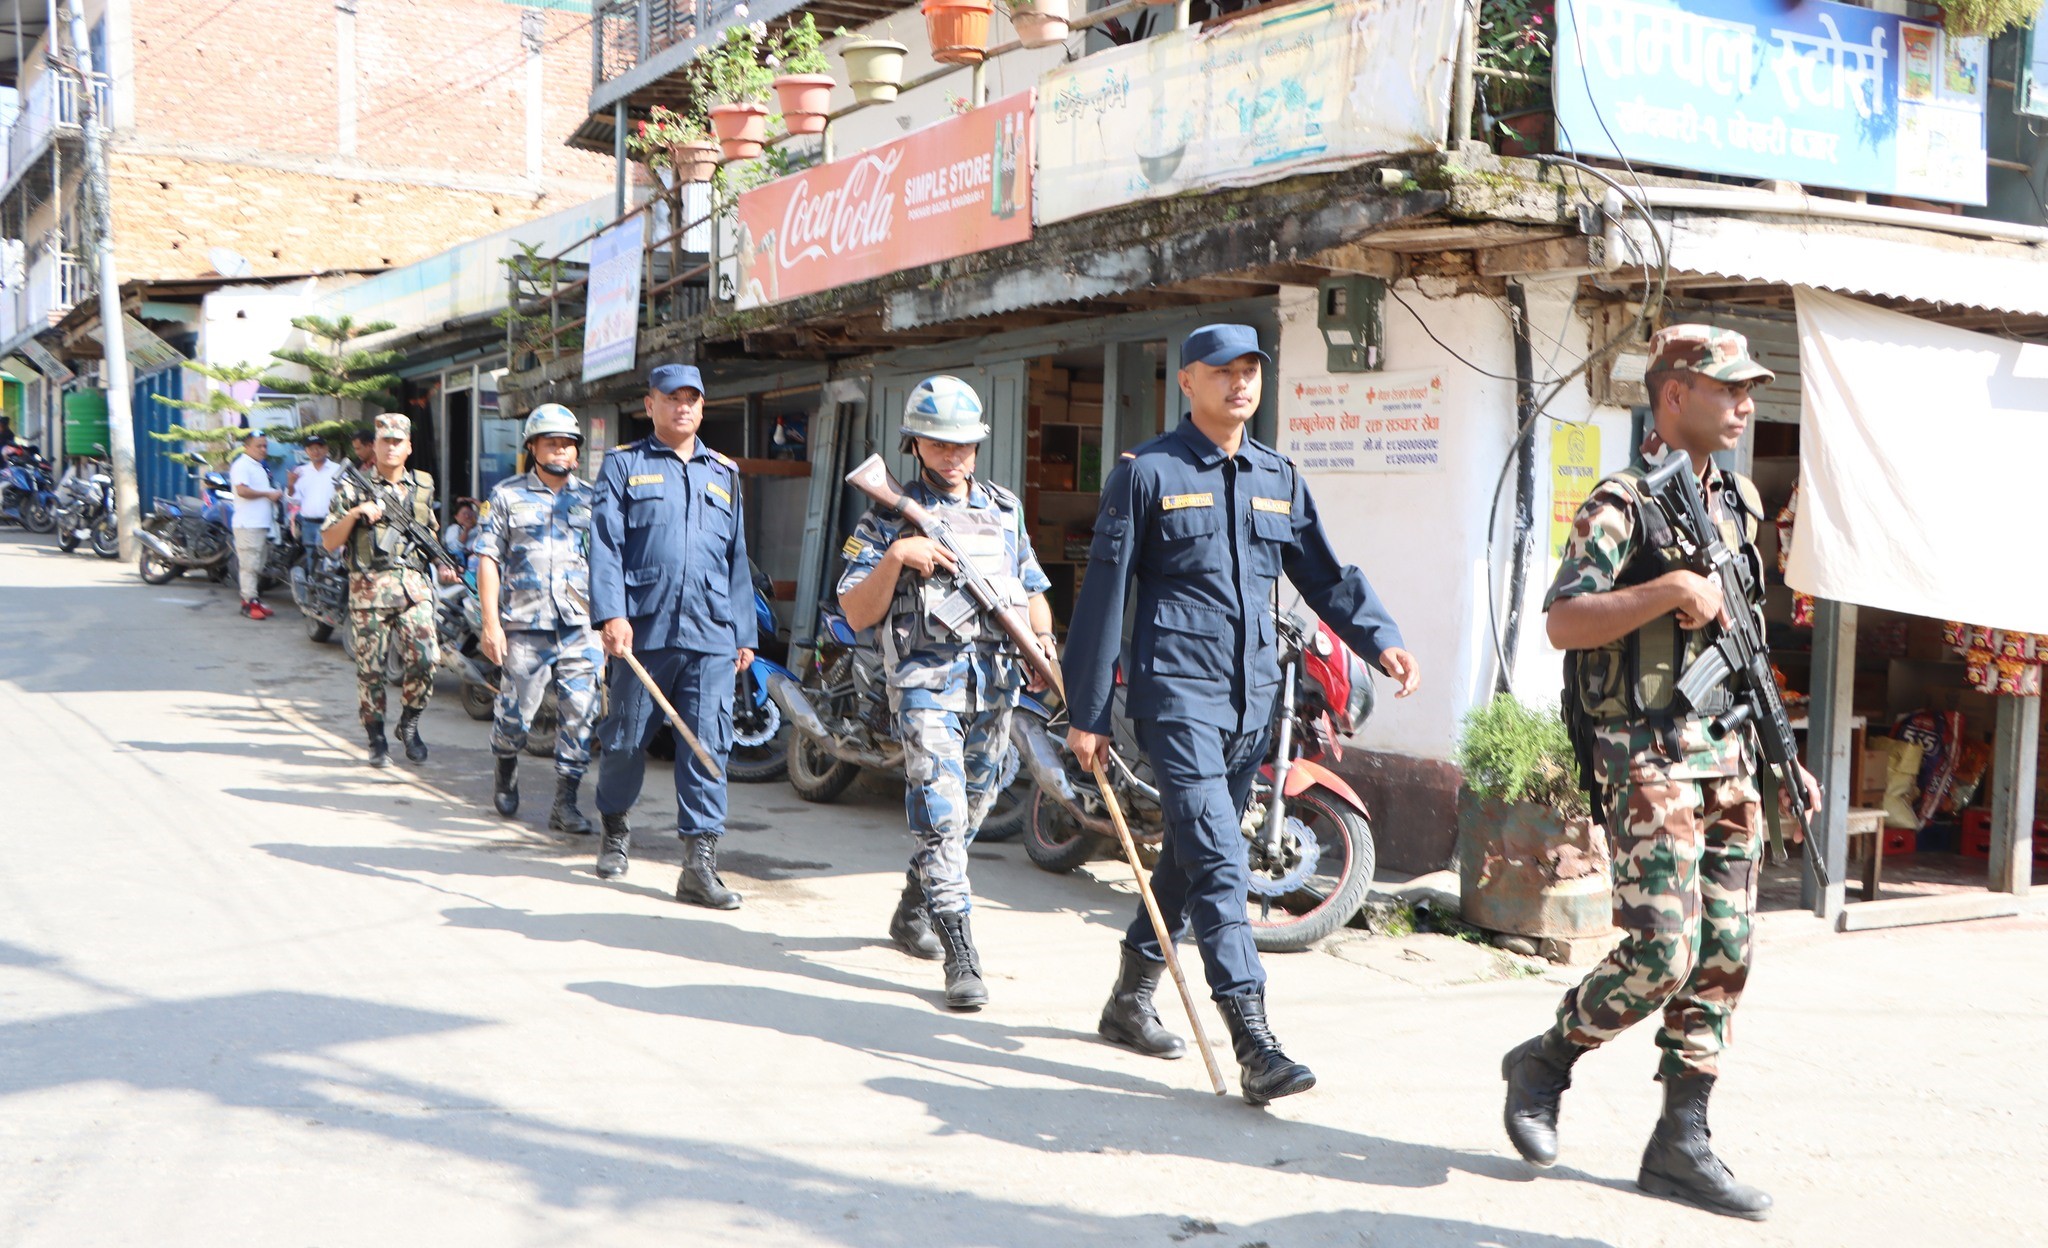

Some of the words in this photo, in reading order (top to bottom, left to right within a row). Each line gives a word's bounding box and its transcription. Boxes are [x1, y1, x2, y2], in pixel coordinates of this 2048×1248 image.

[1770, 13, 1889, 120] स्टोर्स
[904, 167, 947, 206] SIMPLE
[949, 152, 991, 193] STORE
[1340, 411, 1361, 431] सेवा
[1421, 412, 1440, 431] सेवा
